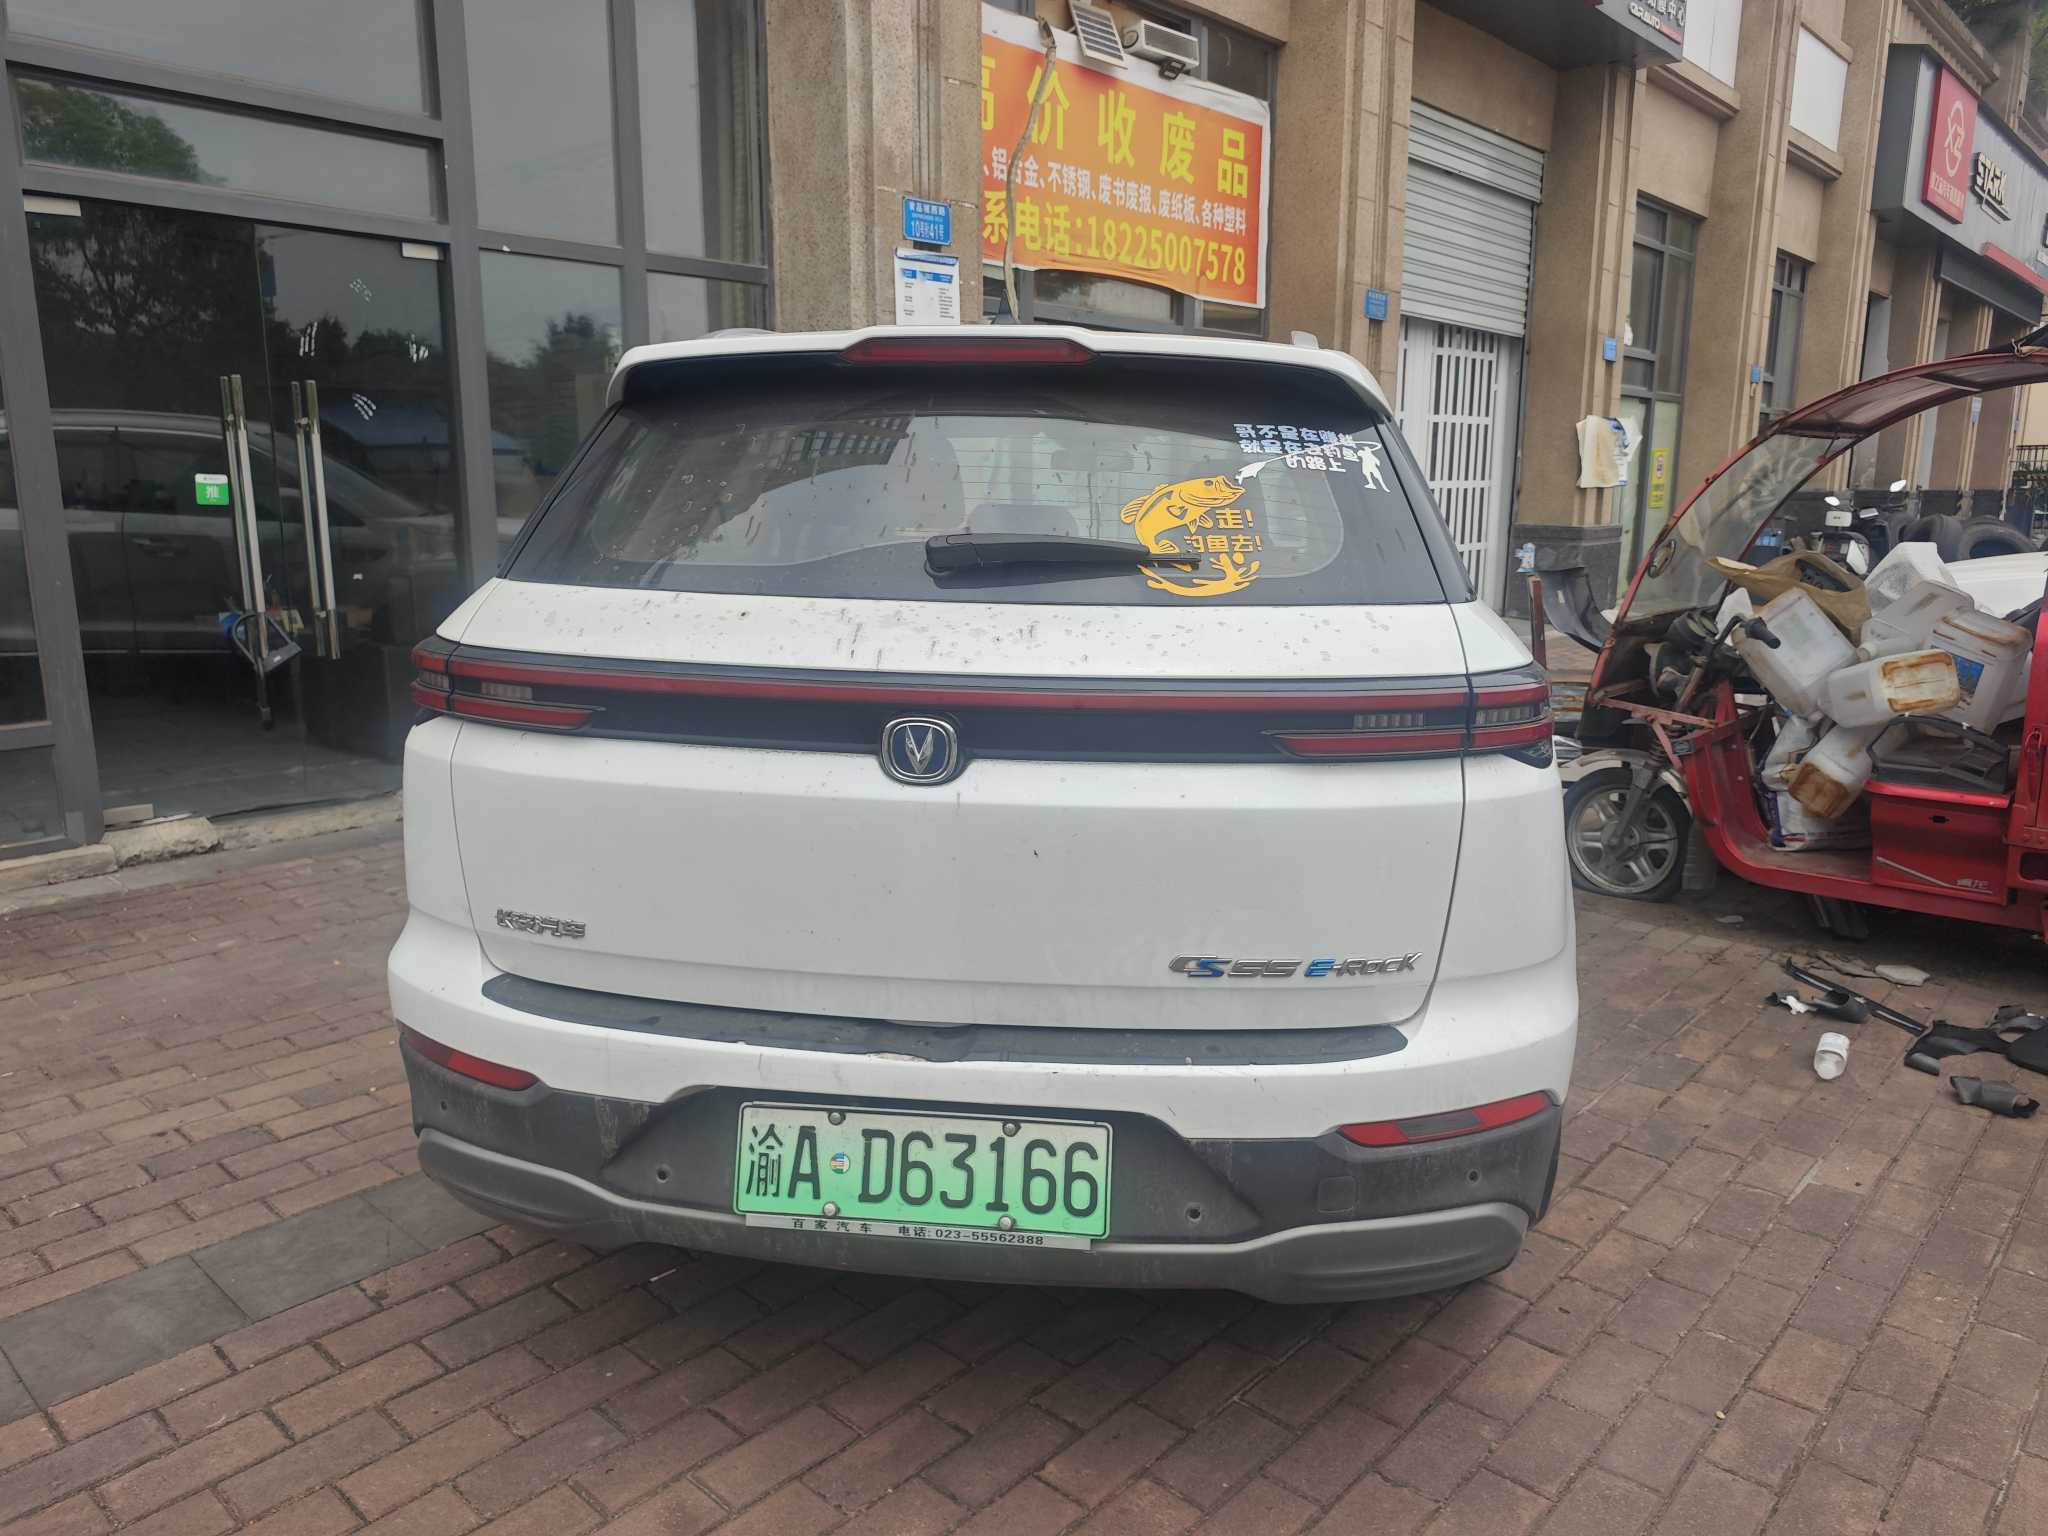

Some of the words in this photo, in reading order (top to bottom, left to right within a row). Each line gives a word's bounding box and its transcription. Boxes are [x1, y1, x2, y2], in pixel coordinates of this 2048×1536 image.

[1285, 454, 1346, 473] 的路上
[1168, 953, 1302, 978] CS55
[792, 1217, 873, 1234] 百家汽车
